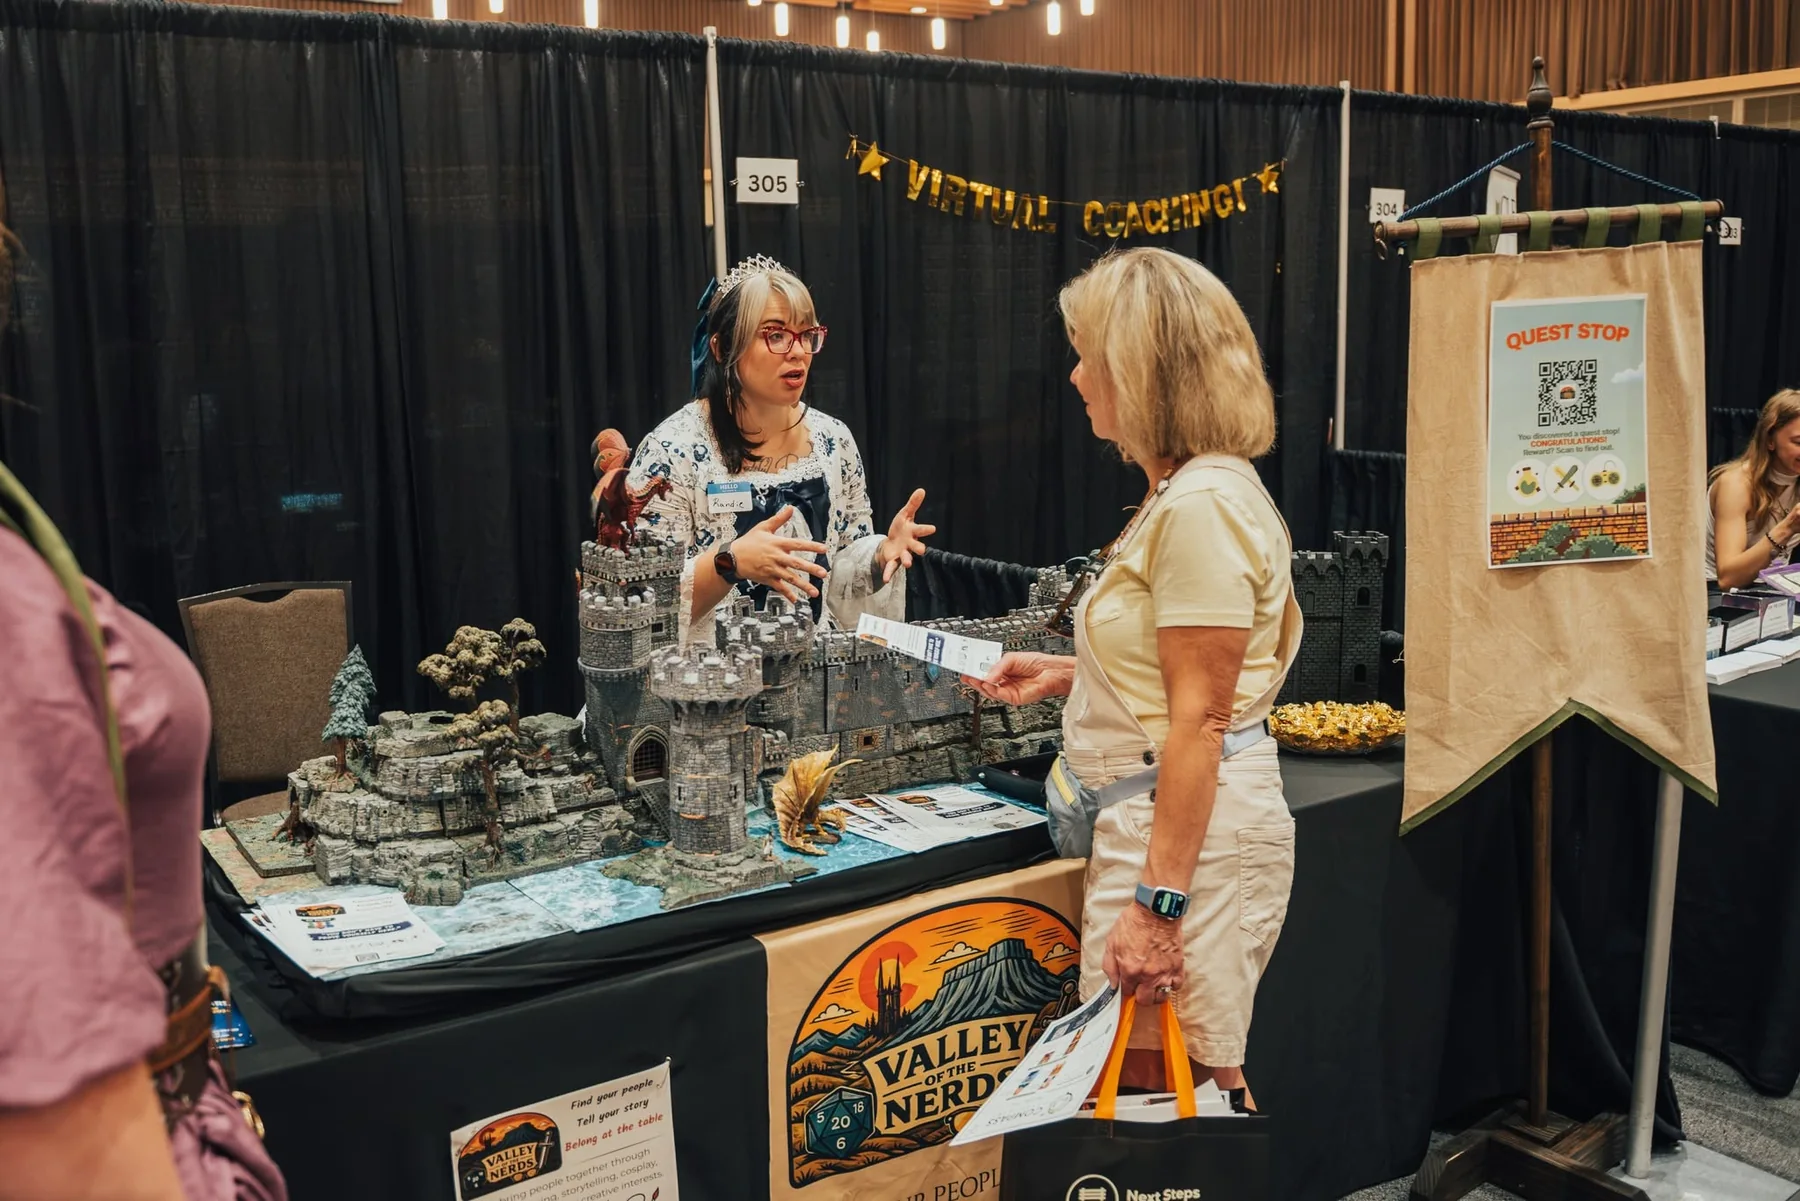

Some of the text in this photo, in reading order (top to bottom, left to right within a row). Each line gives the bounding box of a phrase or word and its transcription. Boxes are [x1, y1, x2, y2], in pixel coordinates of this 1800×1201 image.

[748, 174, 787, 193] 305
[906, 158, 1247, 239] VIRTUAL COACHING!
[1376, 202, 1397, 216] 304
[1506, 322, 1630, 352] QUEST STOP
[1518, 433, 1531, 441] You
[1532, 430, 1573, 440] discovered
[1580, 428, 1600, 439] quest
[1602, 426, 1621, 436] stop!
[1530, 436, 1608, 448] CONGRATULATIONS!
[1523, 443, 1615, 456] Reward? Scan to find out.
[875, 1019, 1028, 1086] VALLEY
[924, 1061, 976, 1086] OF THE
[570, 1078, 654, 1110] Find your people
[577, 1099, 650, 1127] Tell your story
[816, 1111, 825, 1124] 5
[831, 1115, 851, 1131] 20
[564, 1112, 664, 1152] Belong at the table
[836, 1136, 846, 1150] 6
[486, 1145, 534, 1167] VALLEY
[490, 1158, 534, 1181] NERDS
[529, 1176, 564, 1196] people
[565, 1163, 609, 1183] together
[611, 1148, 651, 1168] through
[561, 1175, 619, 1198] storytelling,
[620, 1160, 658, 1177] cosplay,
[581, 1171, 664, 1201] creative interests.
[934, 1167, 1001, 1201] PEOPL
[1126, 1188, 1201, 1201] Next Steps
